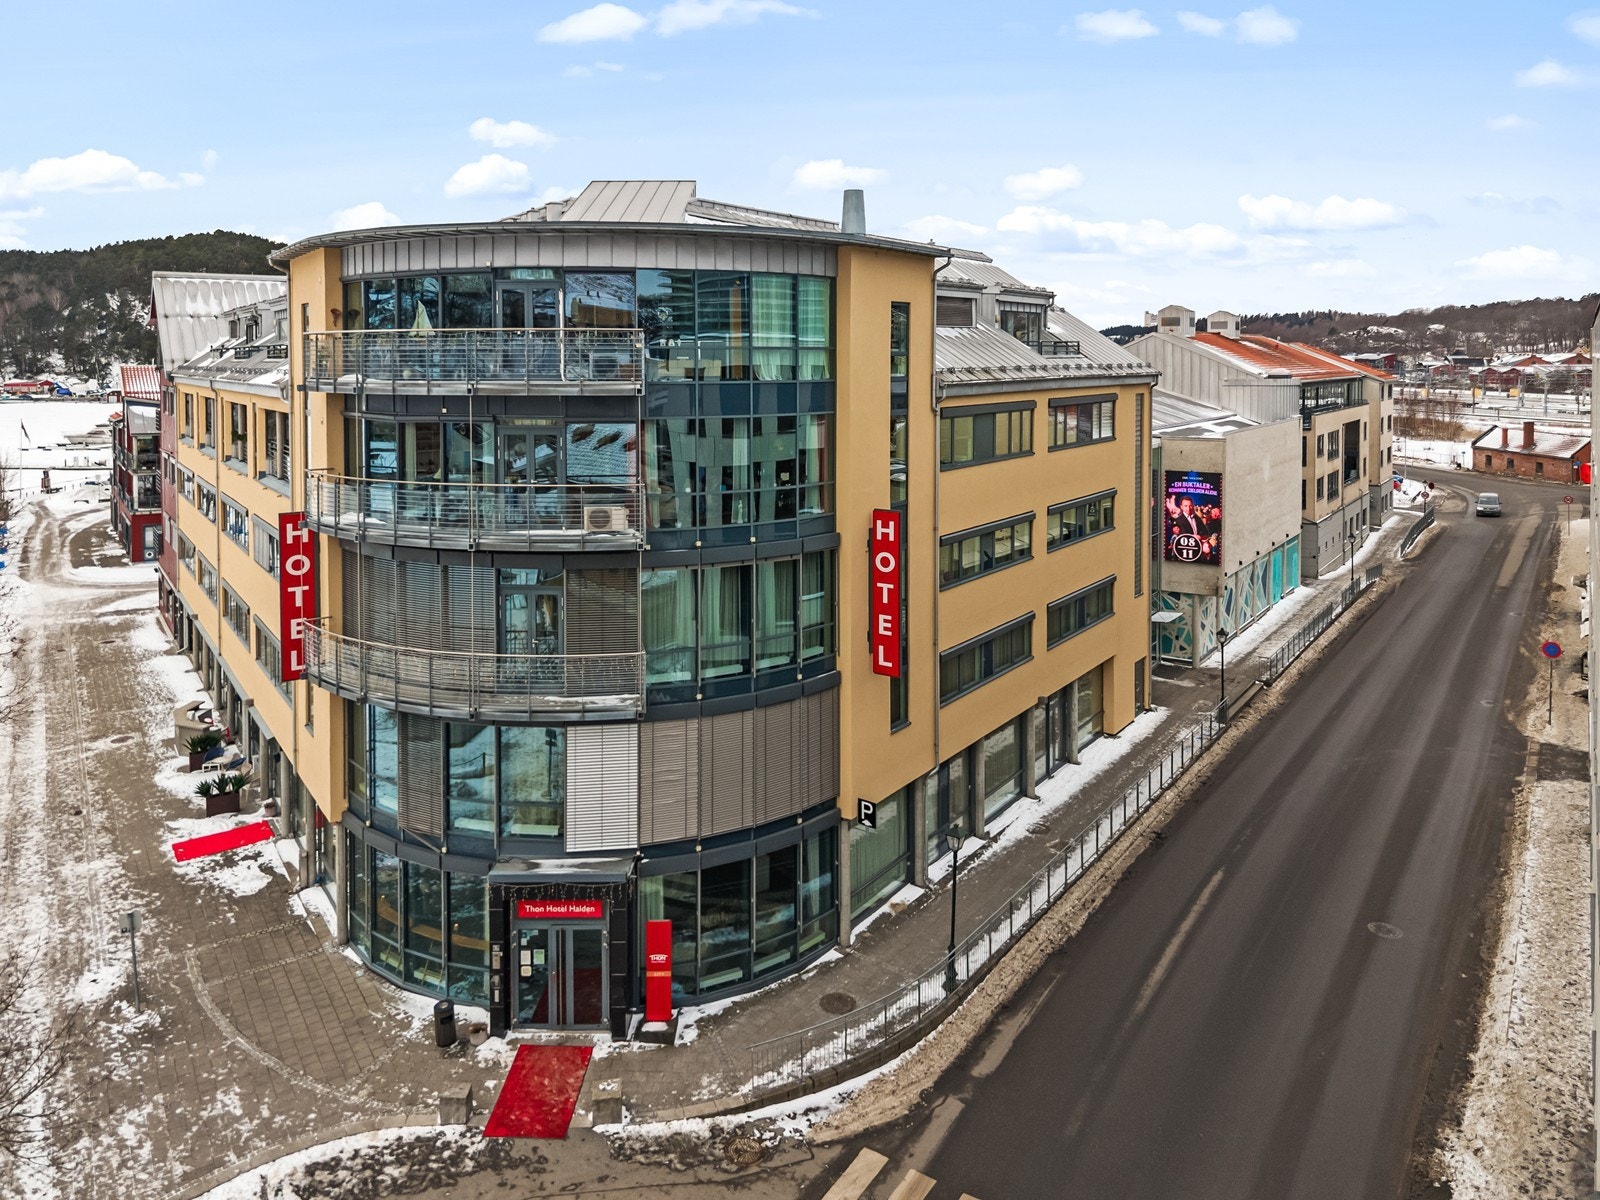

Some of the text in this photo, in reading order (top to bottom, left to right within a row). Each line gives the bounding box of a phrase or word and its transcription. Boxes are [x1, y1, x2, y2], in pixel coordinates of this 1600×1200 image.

[1180, 536, 1196, 546] 08
[1182, 549, 1194, 559] 11
[285, 522, 311, 671] HOTEL
[875, 519, 896, 668] HOTEL
[861, 801, 873, 819] P
[525, 904, 595, 913] Thon Hotel Halden
